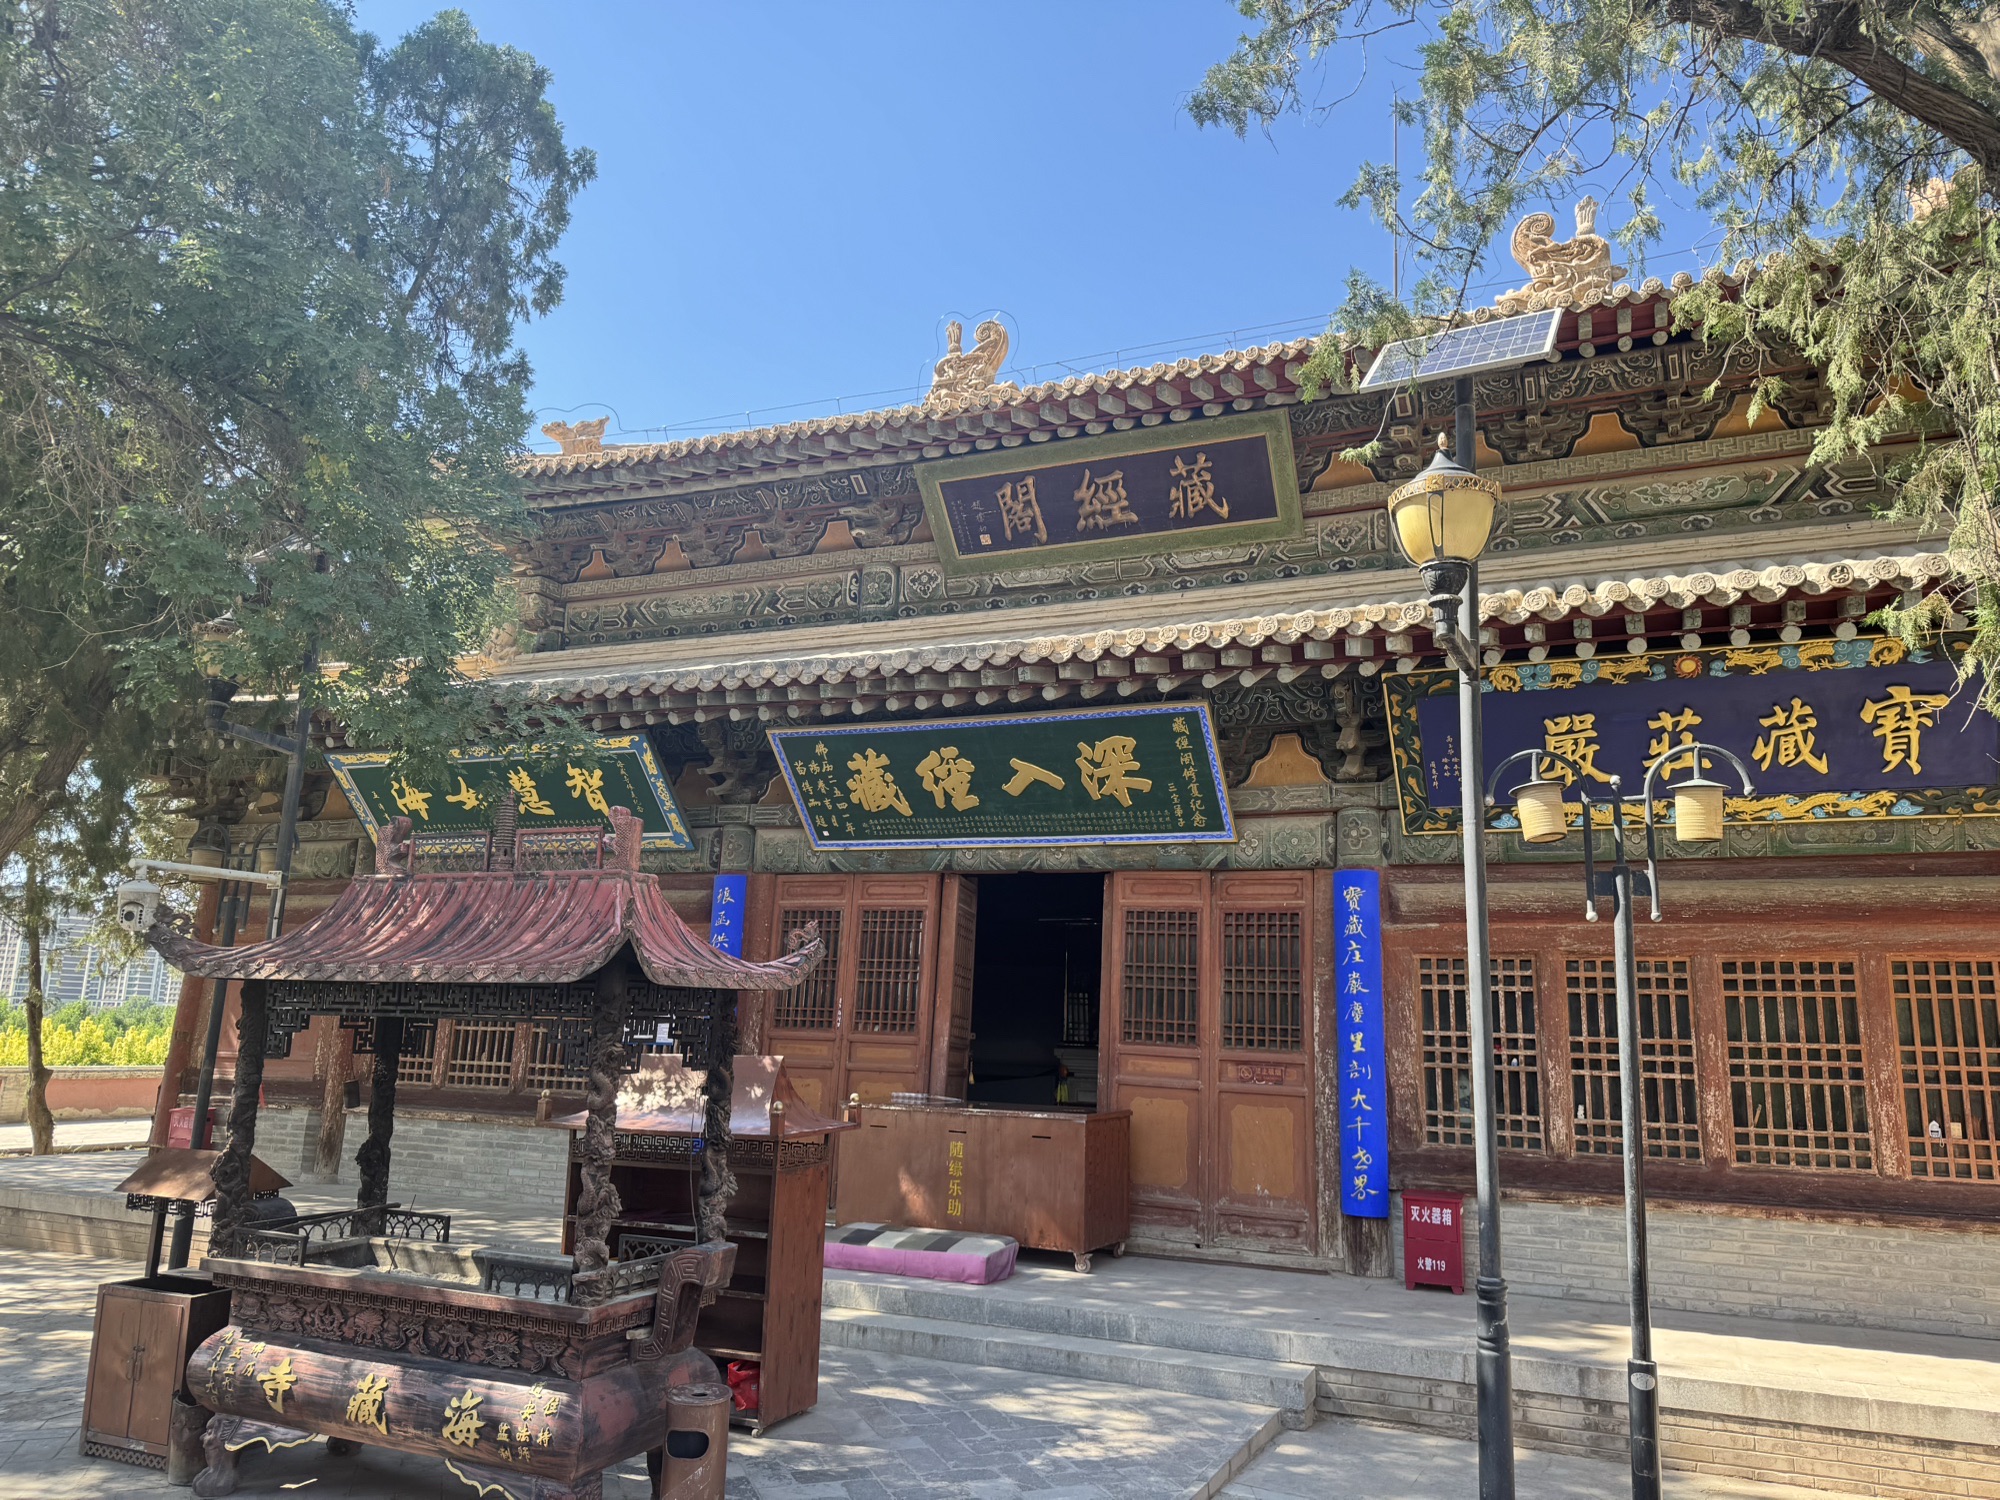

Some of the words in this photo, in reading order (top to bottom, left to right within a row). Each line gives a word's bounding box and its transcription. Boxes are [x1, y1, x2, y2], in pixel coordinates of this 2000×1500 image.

[994, 451, 1229, 545] 藏經閣
[947, 1141, 964, 1216] 随缘乐助
[1411, 1206, 1452, 1226] 灭火器箱
[1417, 1257, 1446, 1271] 火警119
[241, 1341, 266, 1377] 佛历
[256, 1357, 487, 1448] 海藏寺
[537, 1397, 560, 1447] 住持
